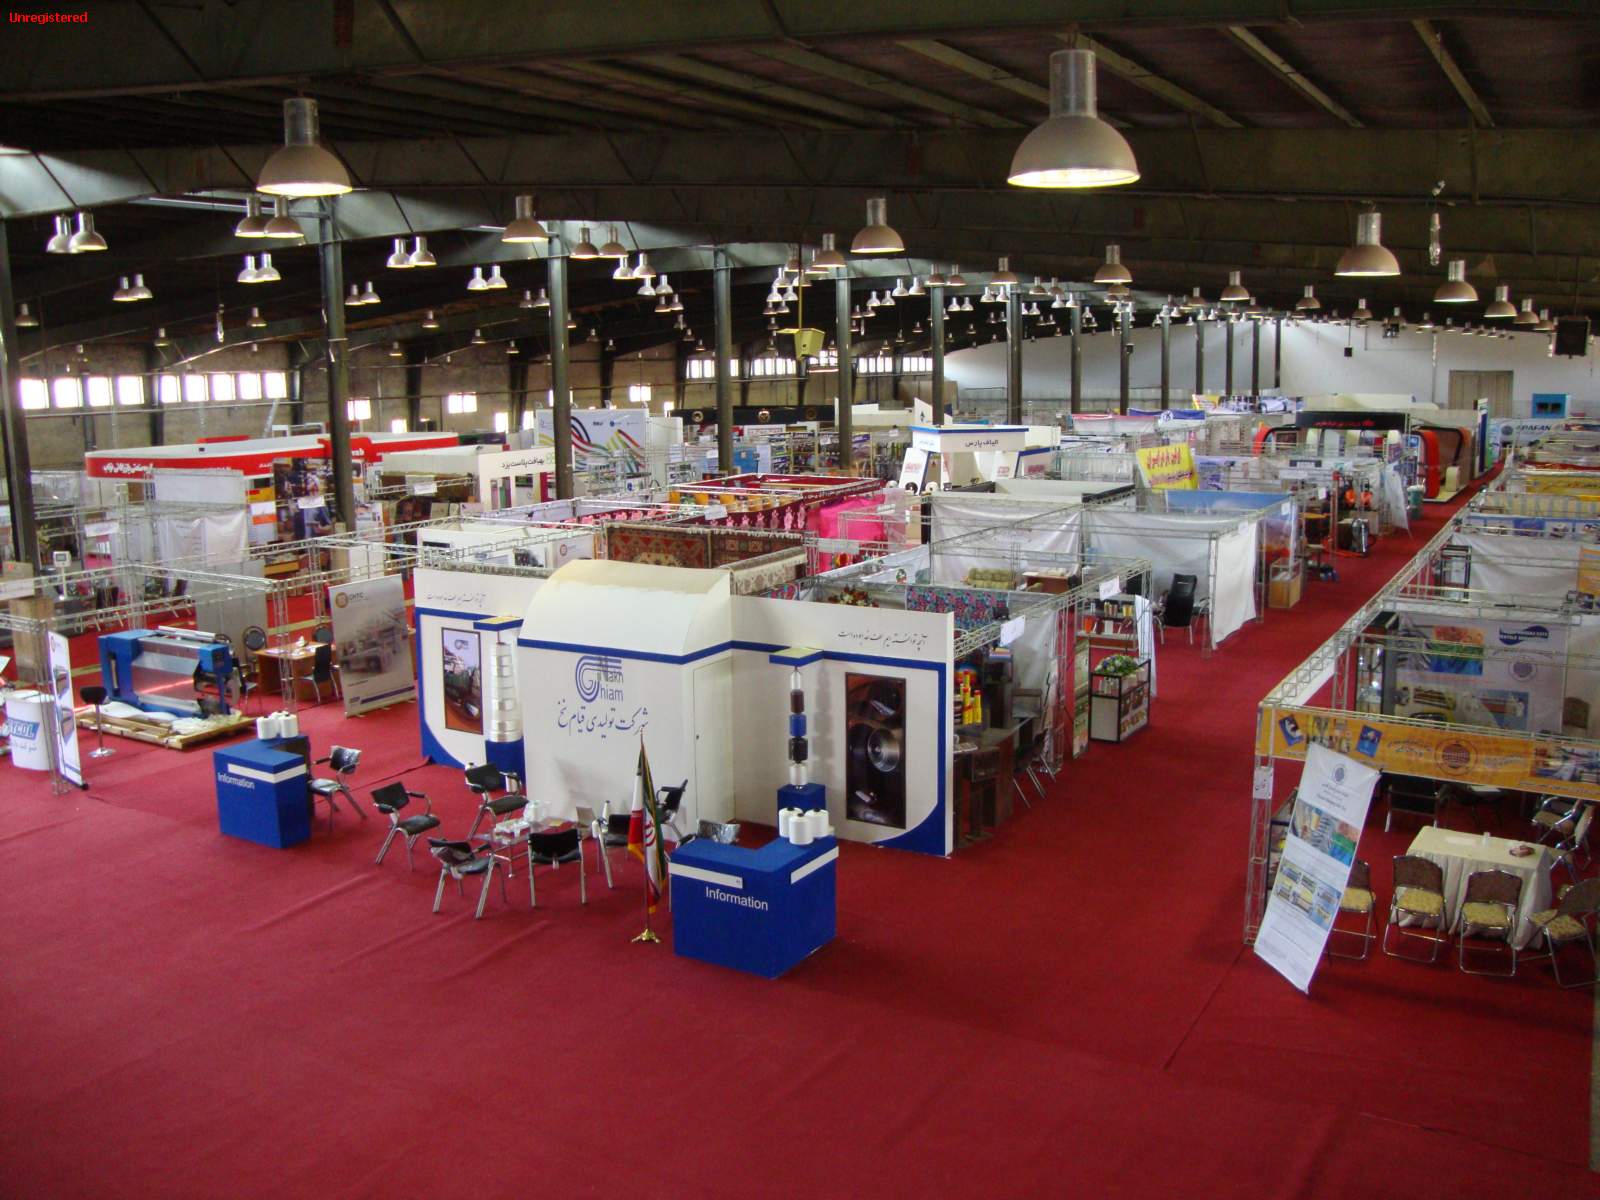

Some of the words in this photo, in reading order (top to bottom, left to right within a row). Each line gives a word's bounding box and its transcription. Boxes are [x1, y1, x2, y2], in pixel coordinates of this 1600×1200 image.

[557, 698, 569, 728] نخ
[568, 705, 587, 737] قیام
[586, 707, 616, 740] تولیدی
[614, 706, 649, 736] شرکت
[217, 772, 255, 790] Information
[705, 886, 769, 911] Information
